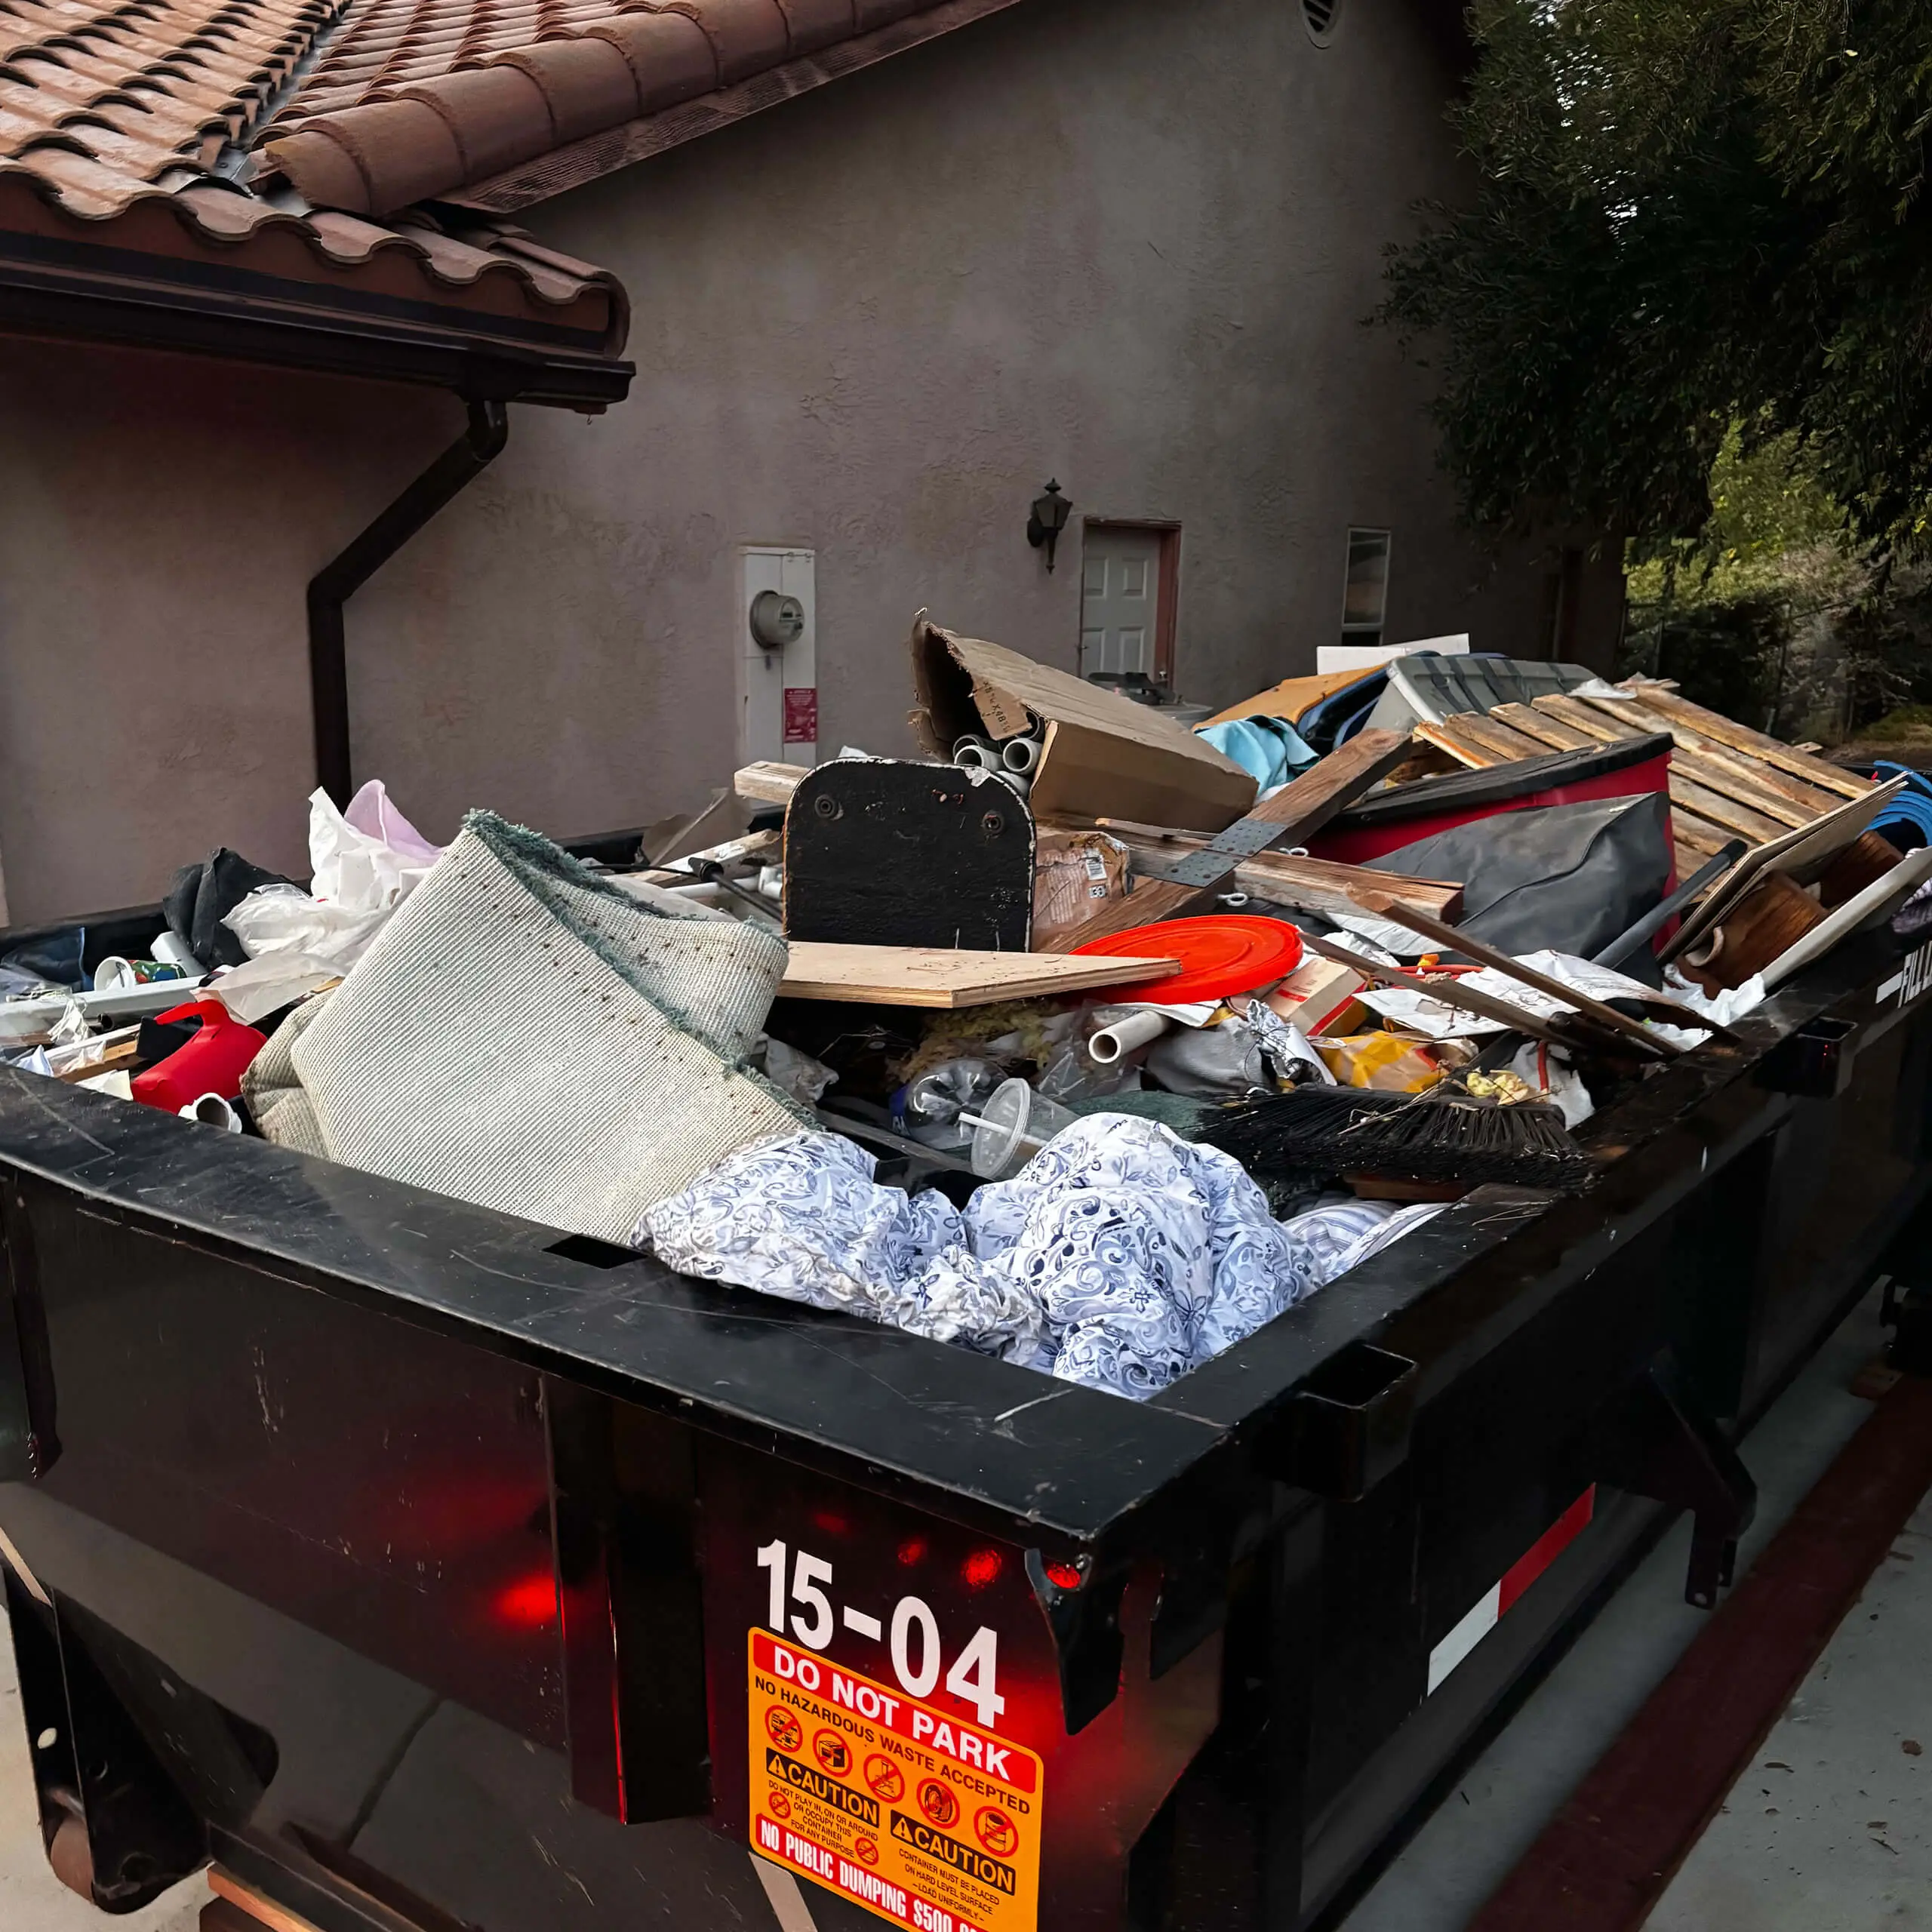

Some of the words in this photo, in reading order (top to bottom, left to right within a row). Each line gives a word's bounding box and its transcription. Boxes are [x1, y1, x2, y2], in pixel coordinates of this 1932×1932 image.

[757, 1539, 1004, 1728] 15-04
[774, 1645, 820, 1690] DO
[832, 1672, 900, 1727] NOT
[912, 1709, 1011, 1781] PARK
[755, 1675, 776, 1695] NO
[780, 1687, 875, 1743] HAZARDOUS
[879, 1734, 935, 1771] WASTE
[940, 1764, 1030, 1814] ACCEPTED
[768, 1780, 779, 1790] DO
[780, 1785, 794, 1798] NOT
[795, 1793, 813, 1806] PLAY
[824, 1807, 835, 1820] ON
[836, 1815, 847, 1826] OR
[848, 1820, 878, 1841] AROUND
[788, 1763, 877, 1826] CAUTION
[793, 1801, 804, 1812] OR
[805, 1807, 834, 1826] OCCUPY
[836, 1823, 851, 1837] THIS
[791, 1820, 805, 1832] FOR
[806, 1827, 820, 1840] ANY
[821, 1835, 854, 1858] PURPOSE
[802, 1816, 842, 1842] CONTAINER
[761, 1819, 780, 1851] NO
[786, 1832, 834, 1880] PUBLIC
[839, 1859, 906, 1918] DUMPING
[913, 1899, 952, 1932] $500
[899, 1848, 938, 1873] CONTAINER
[940, 1869, 959, 1884] MUST
[960, 1878, 971, 1890] BE
[971, 1884, 1000, 1905] PLACED
[905, 1864, 915, 1875] ON
[916, 1869, 936, 1885] HARD
[937, 1879, 958, 1898] LEVEL
[959, 1892, 993, 1915] SURFACE
[914, 1829, 1013, 1893] CAUTION
